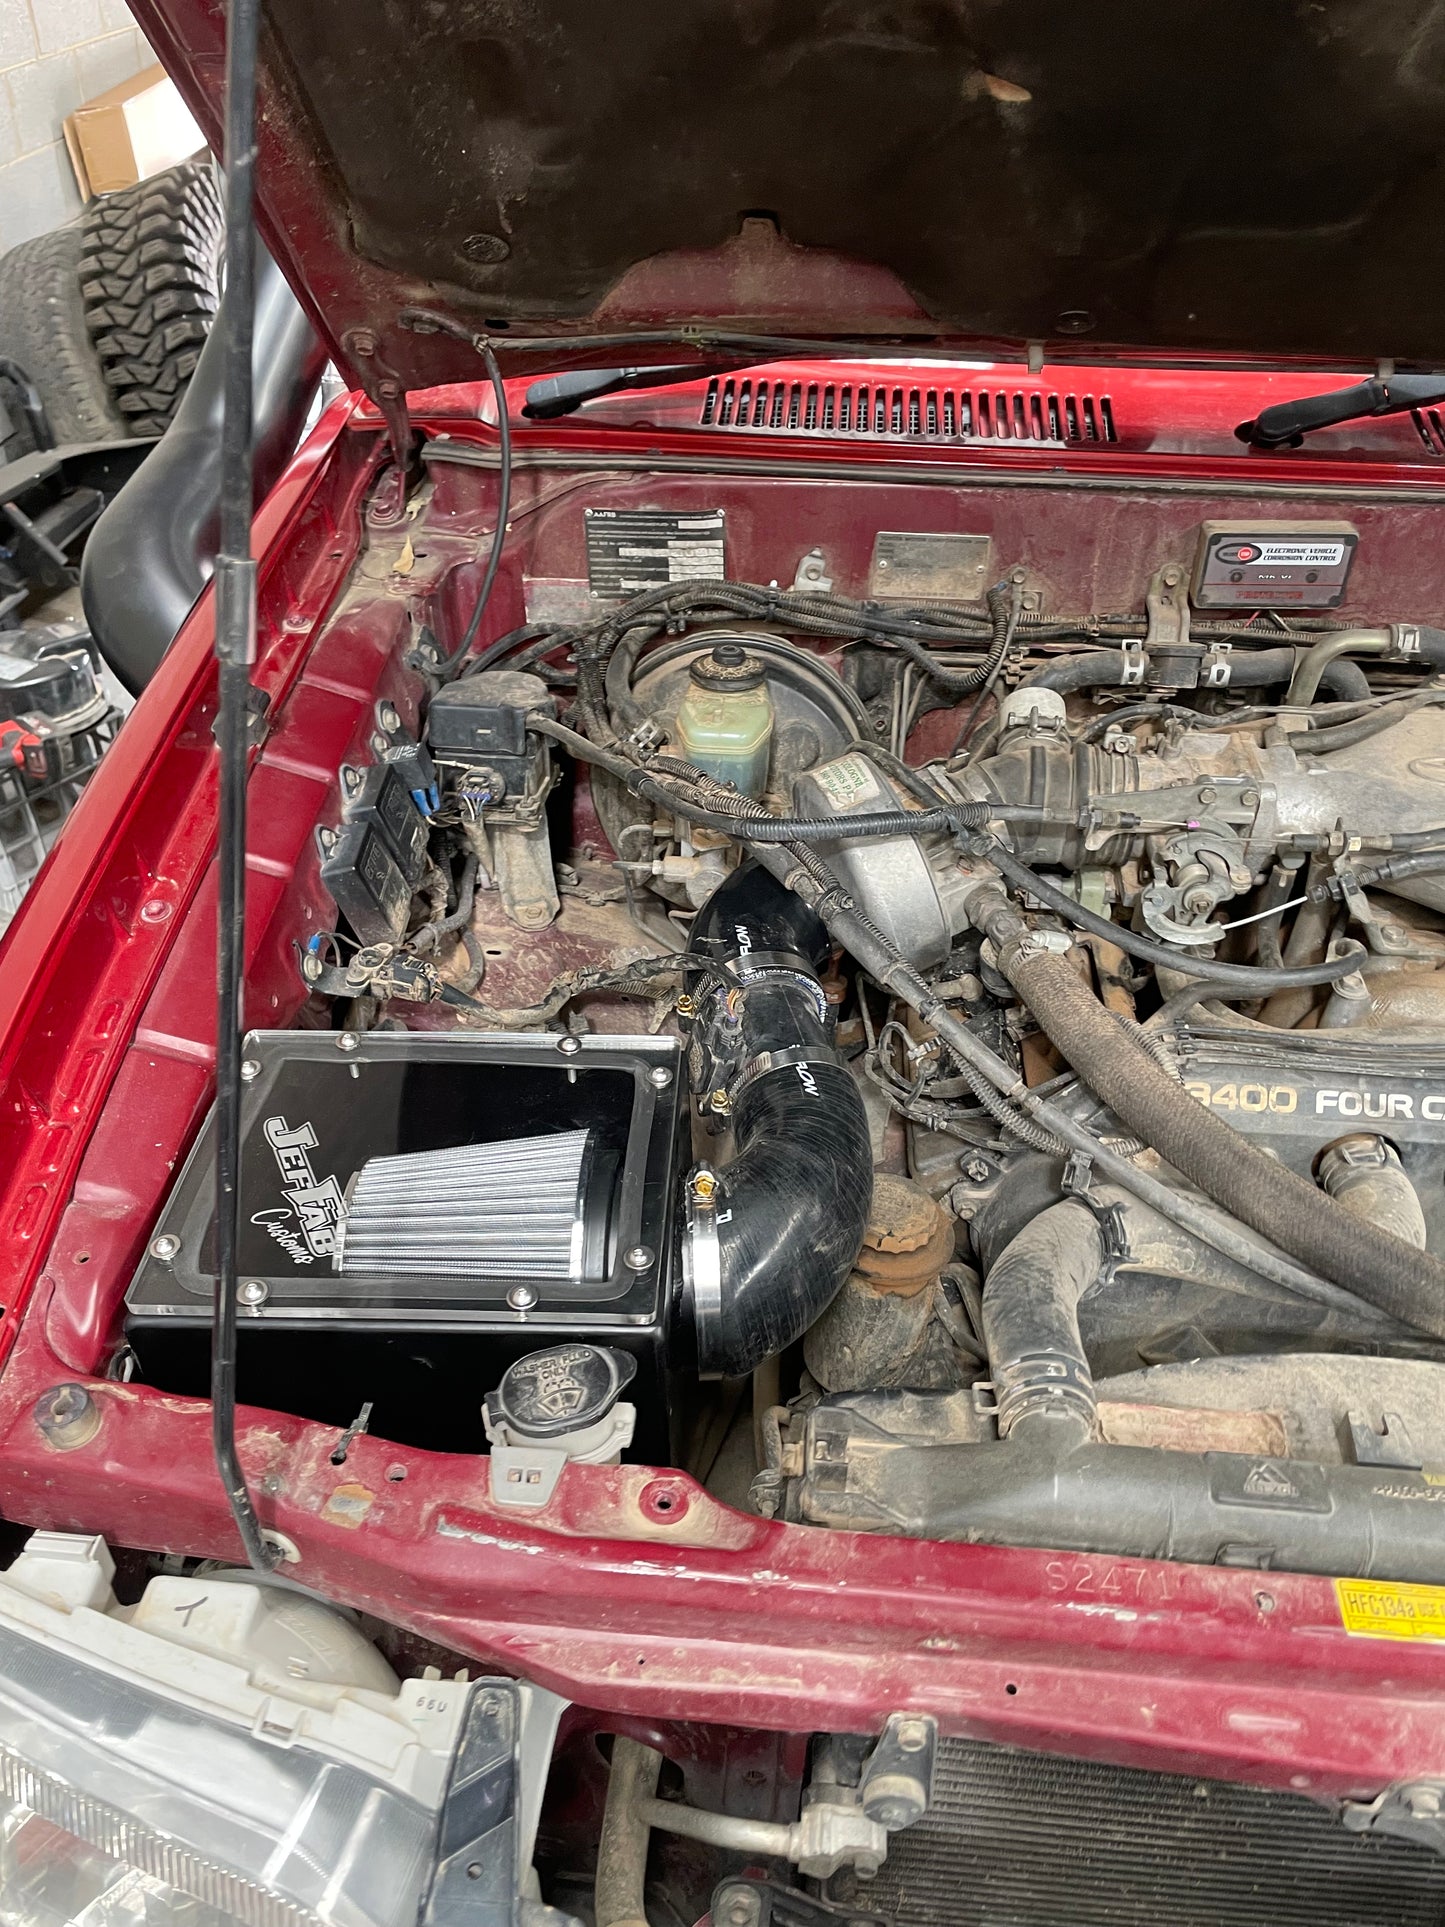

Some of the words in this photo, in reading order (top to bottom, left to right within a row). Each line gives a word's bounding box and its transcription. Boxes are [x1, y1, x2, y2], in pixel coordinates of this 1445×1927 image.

[1315, 1089, 1415, 1120] FOUR
[250, 1207, 315, 1265] Customs
[511, 1358, 557, 1378] WASHER
[541, 1365, 568, 1380] ONLY
